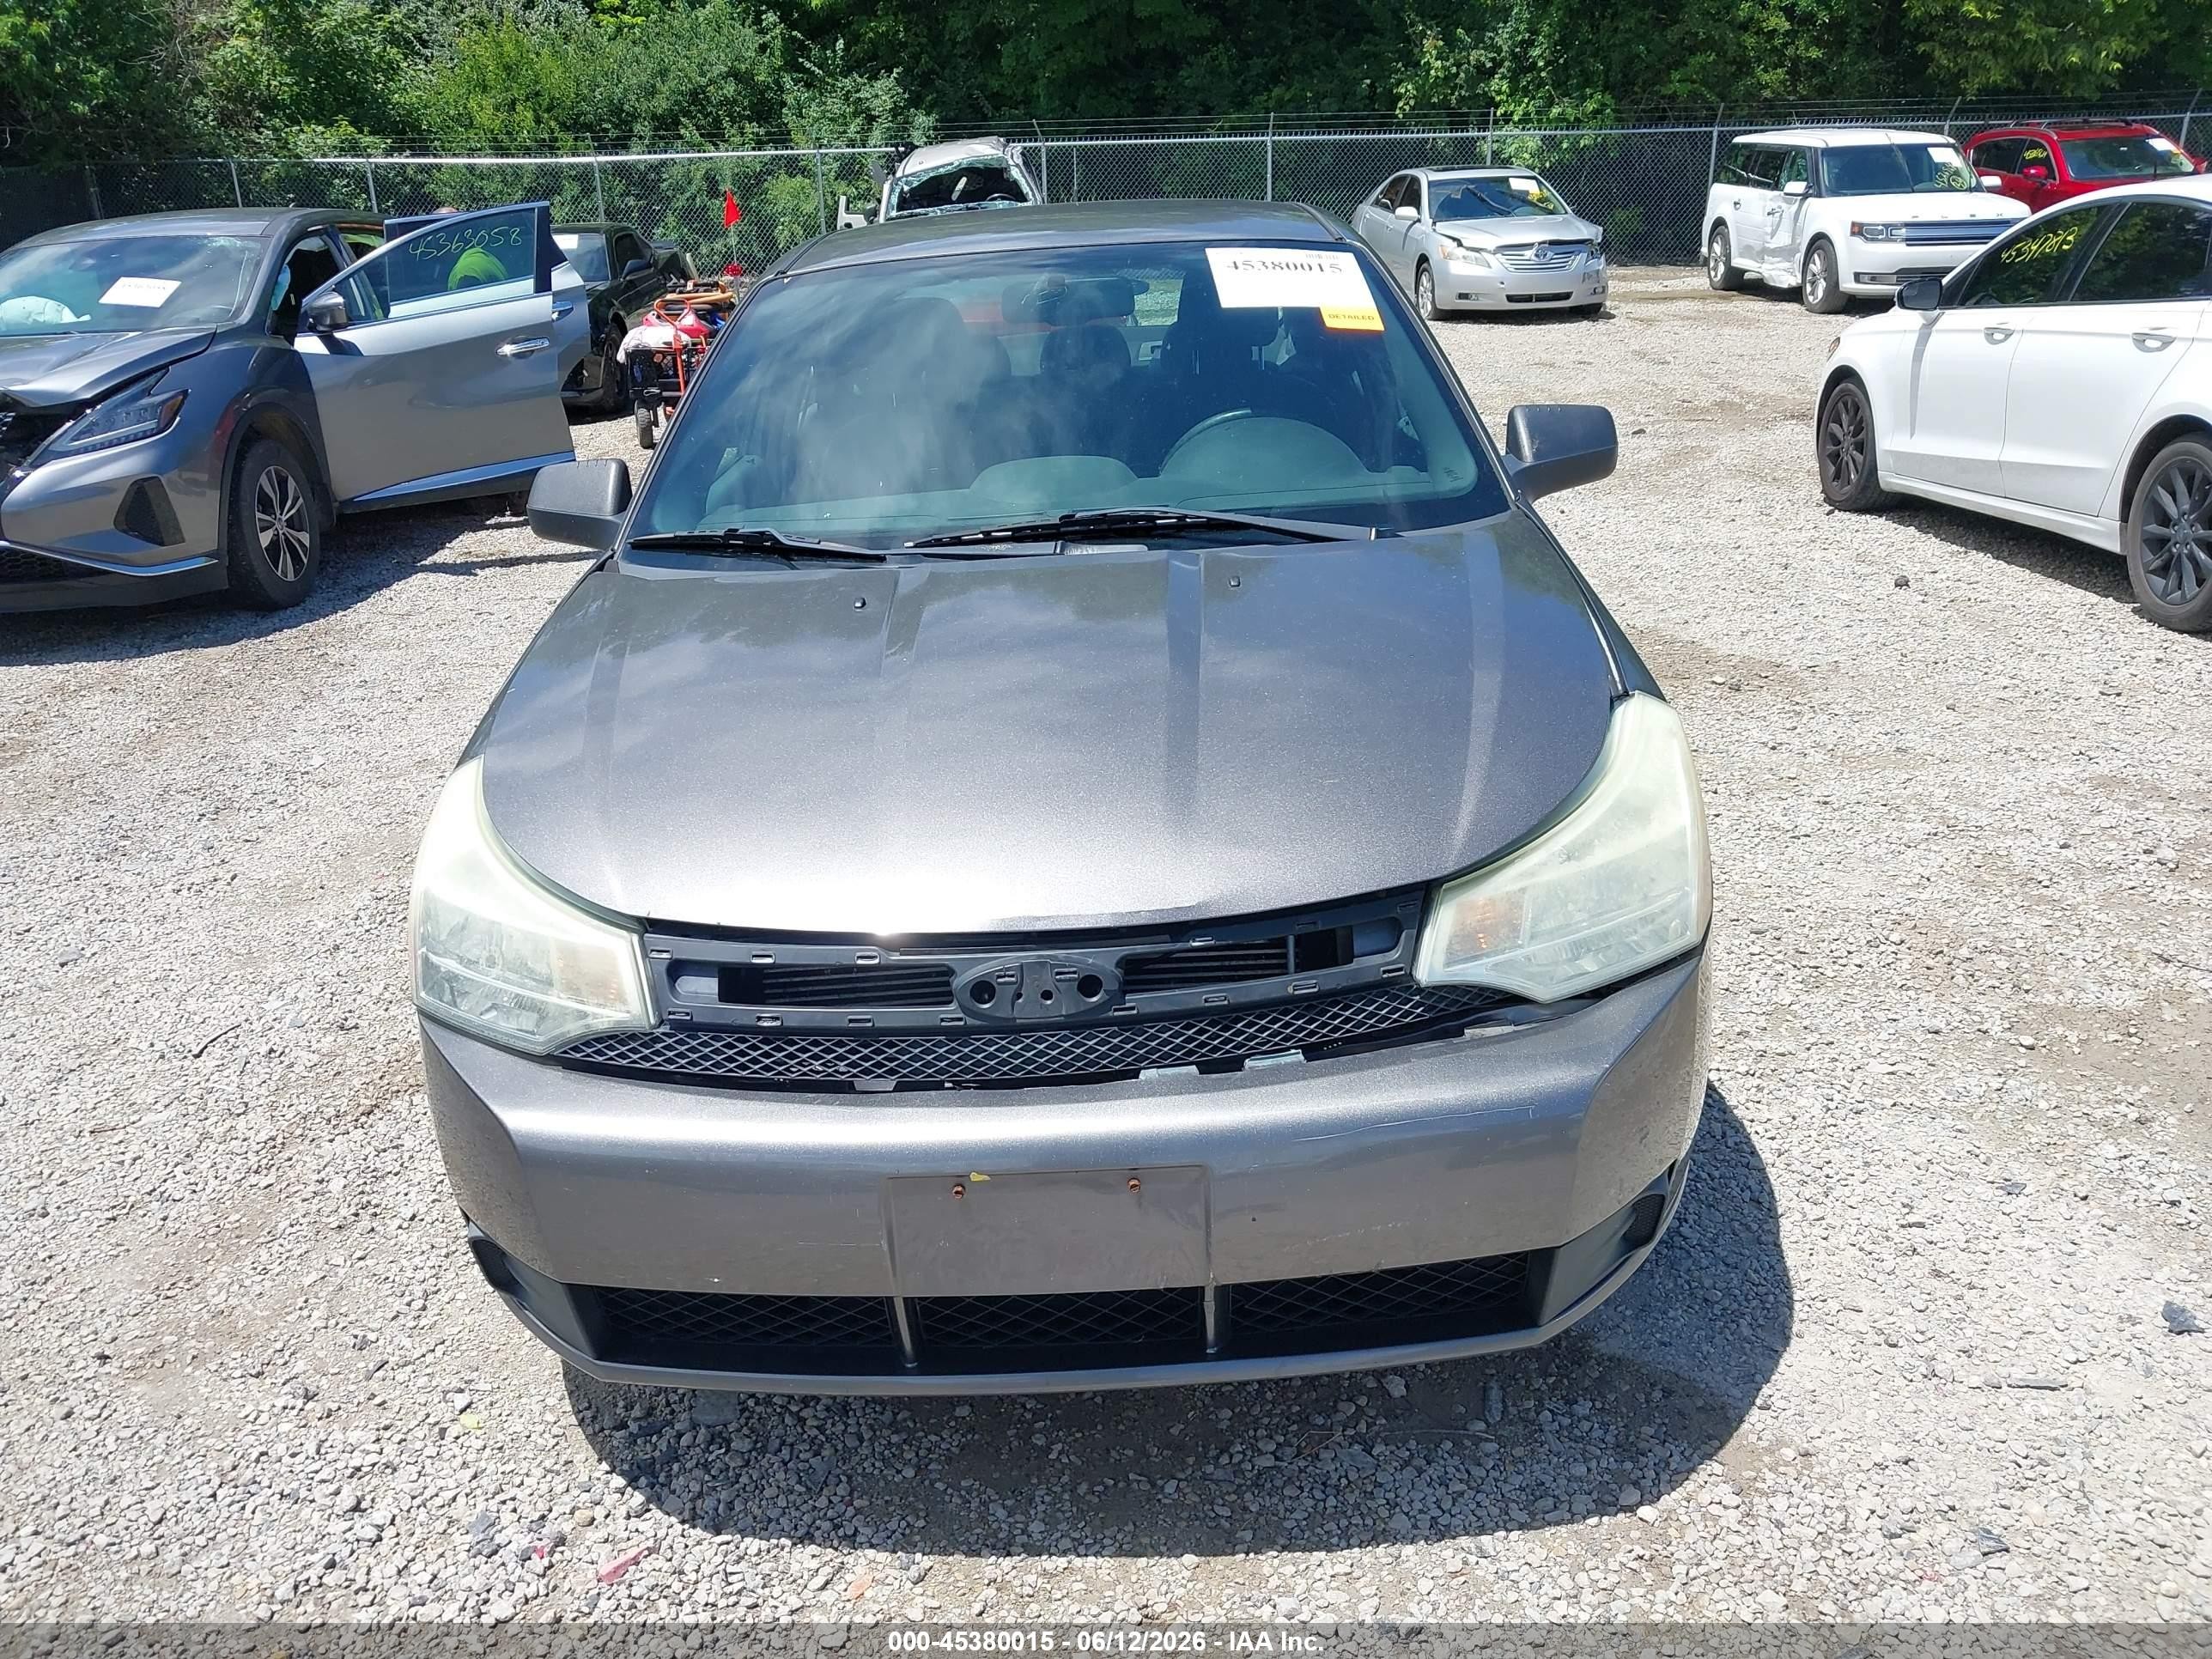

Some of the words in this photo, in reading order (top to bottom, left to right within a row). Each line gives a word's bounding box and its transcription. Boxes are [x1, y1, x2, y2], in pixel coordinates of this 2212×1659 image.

[409, 226, 522, 261] 45363058
[1226, 259, 1343, 274] 45380015
[1328, 313, 1375, 321] DETAILED
